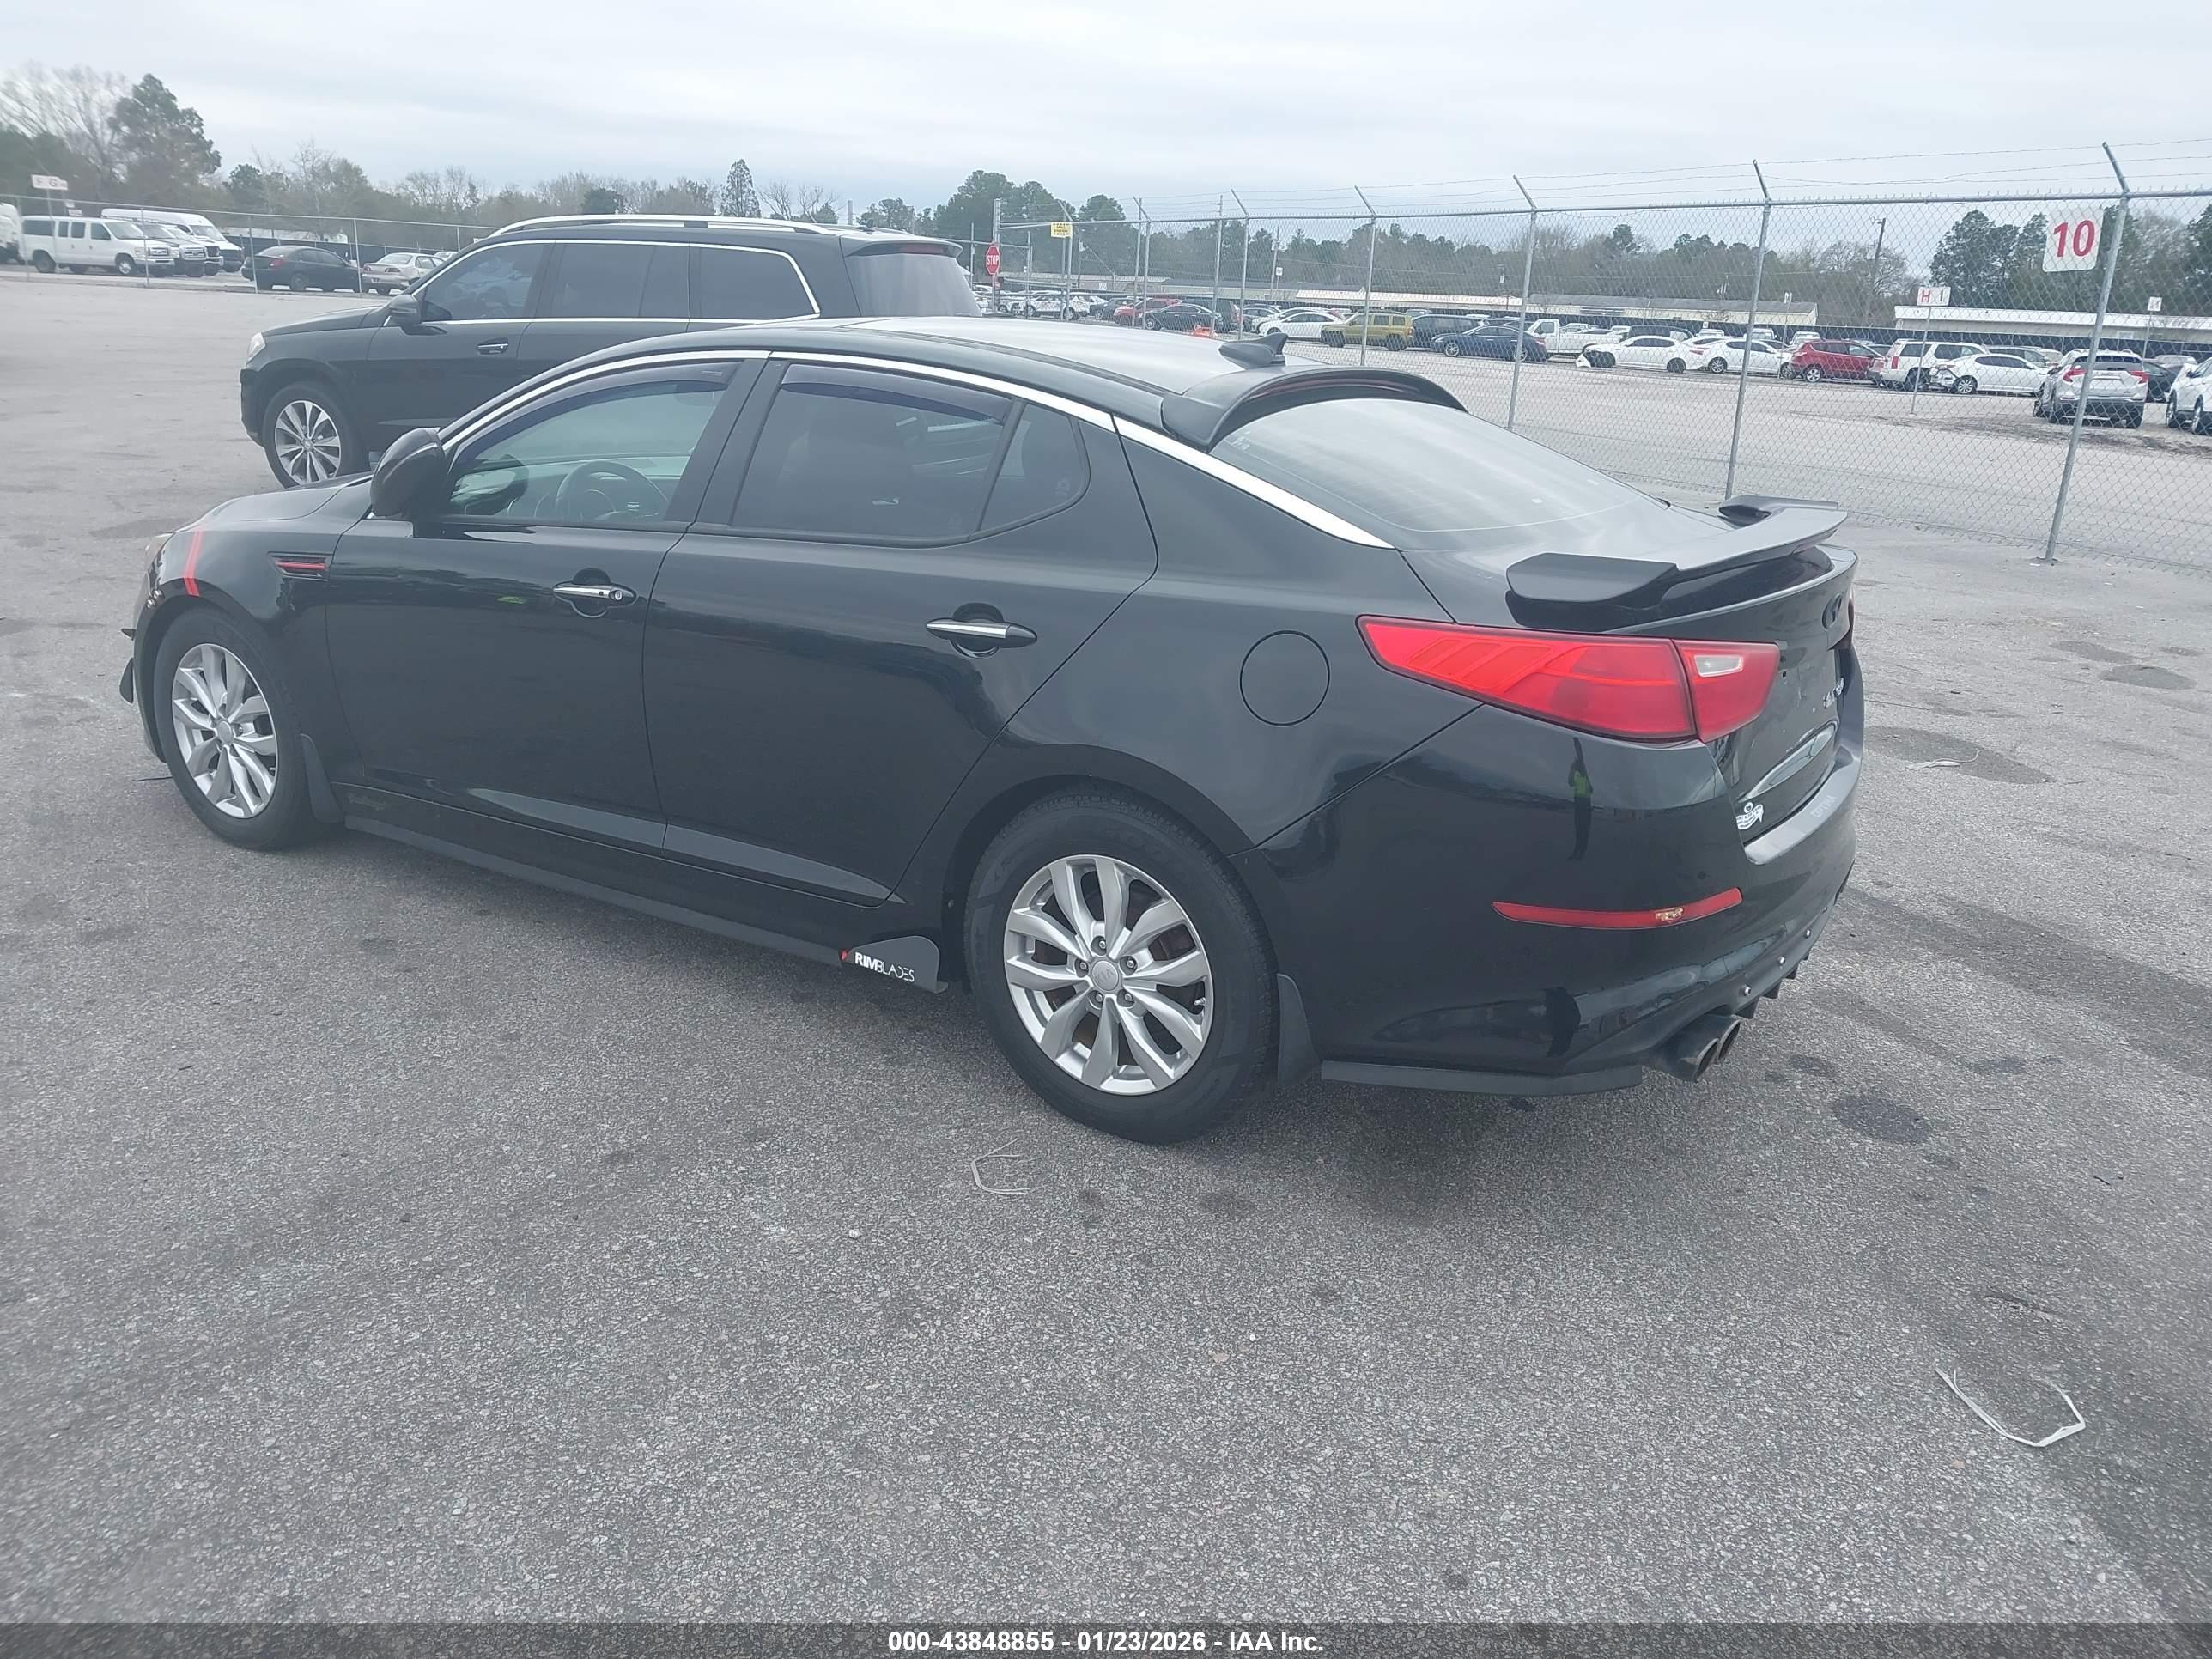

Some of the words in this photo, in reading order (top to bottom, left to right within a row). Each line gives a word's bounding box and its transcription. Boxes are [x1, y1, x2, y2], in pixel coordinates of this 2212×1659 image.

[2053, 219, 2095, 258] 10
[987, 255, 999, 266] STOP
[1921, 289, 1931, 303] H
